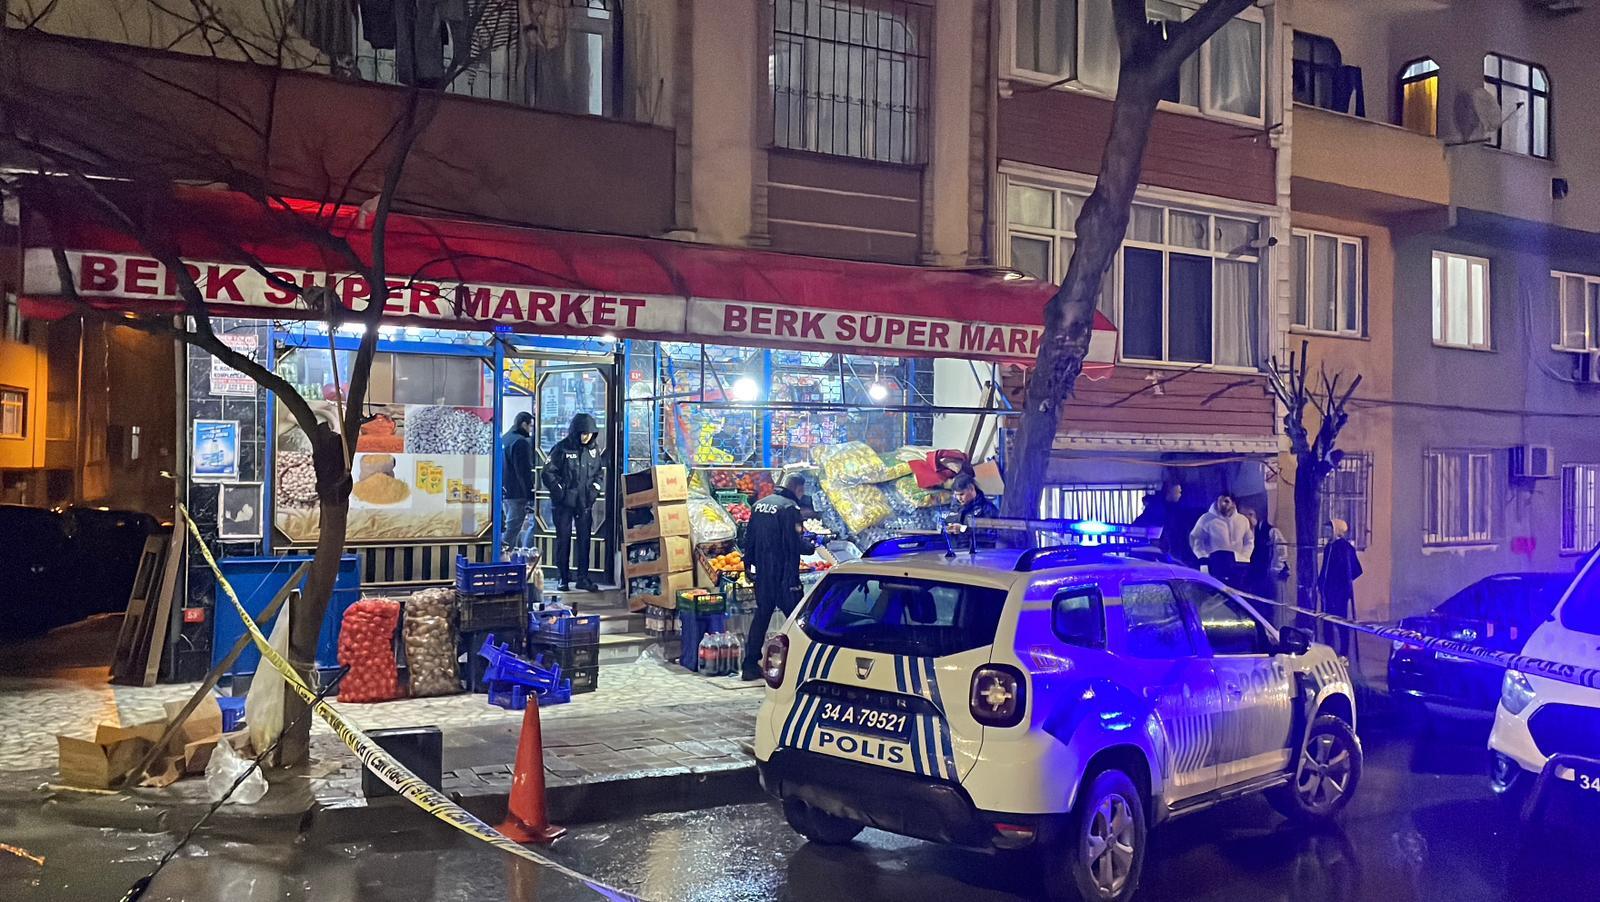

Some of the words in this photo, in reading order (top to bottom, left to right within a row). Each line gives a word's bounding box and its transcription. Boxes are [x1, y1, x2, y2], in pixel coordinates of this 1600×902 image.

[454, 285, 647, 328] MARKET
[723, 304, 827, 340] BERK
[835, 314, 950, 348] SÜPER
[959, 324, 1042, 355] MARK
[821, 703, 841, 721] 34
[841, 706, 854, 724] A
[859, 709, 911, 733] 79521
